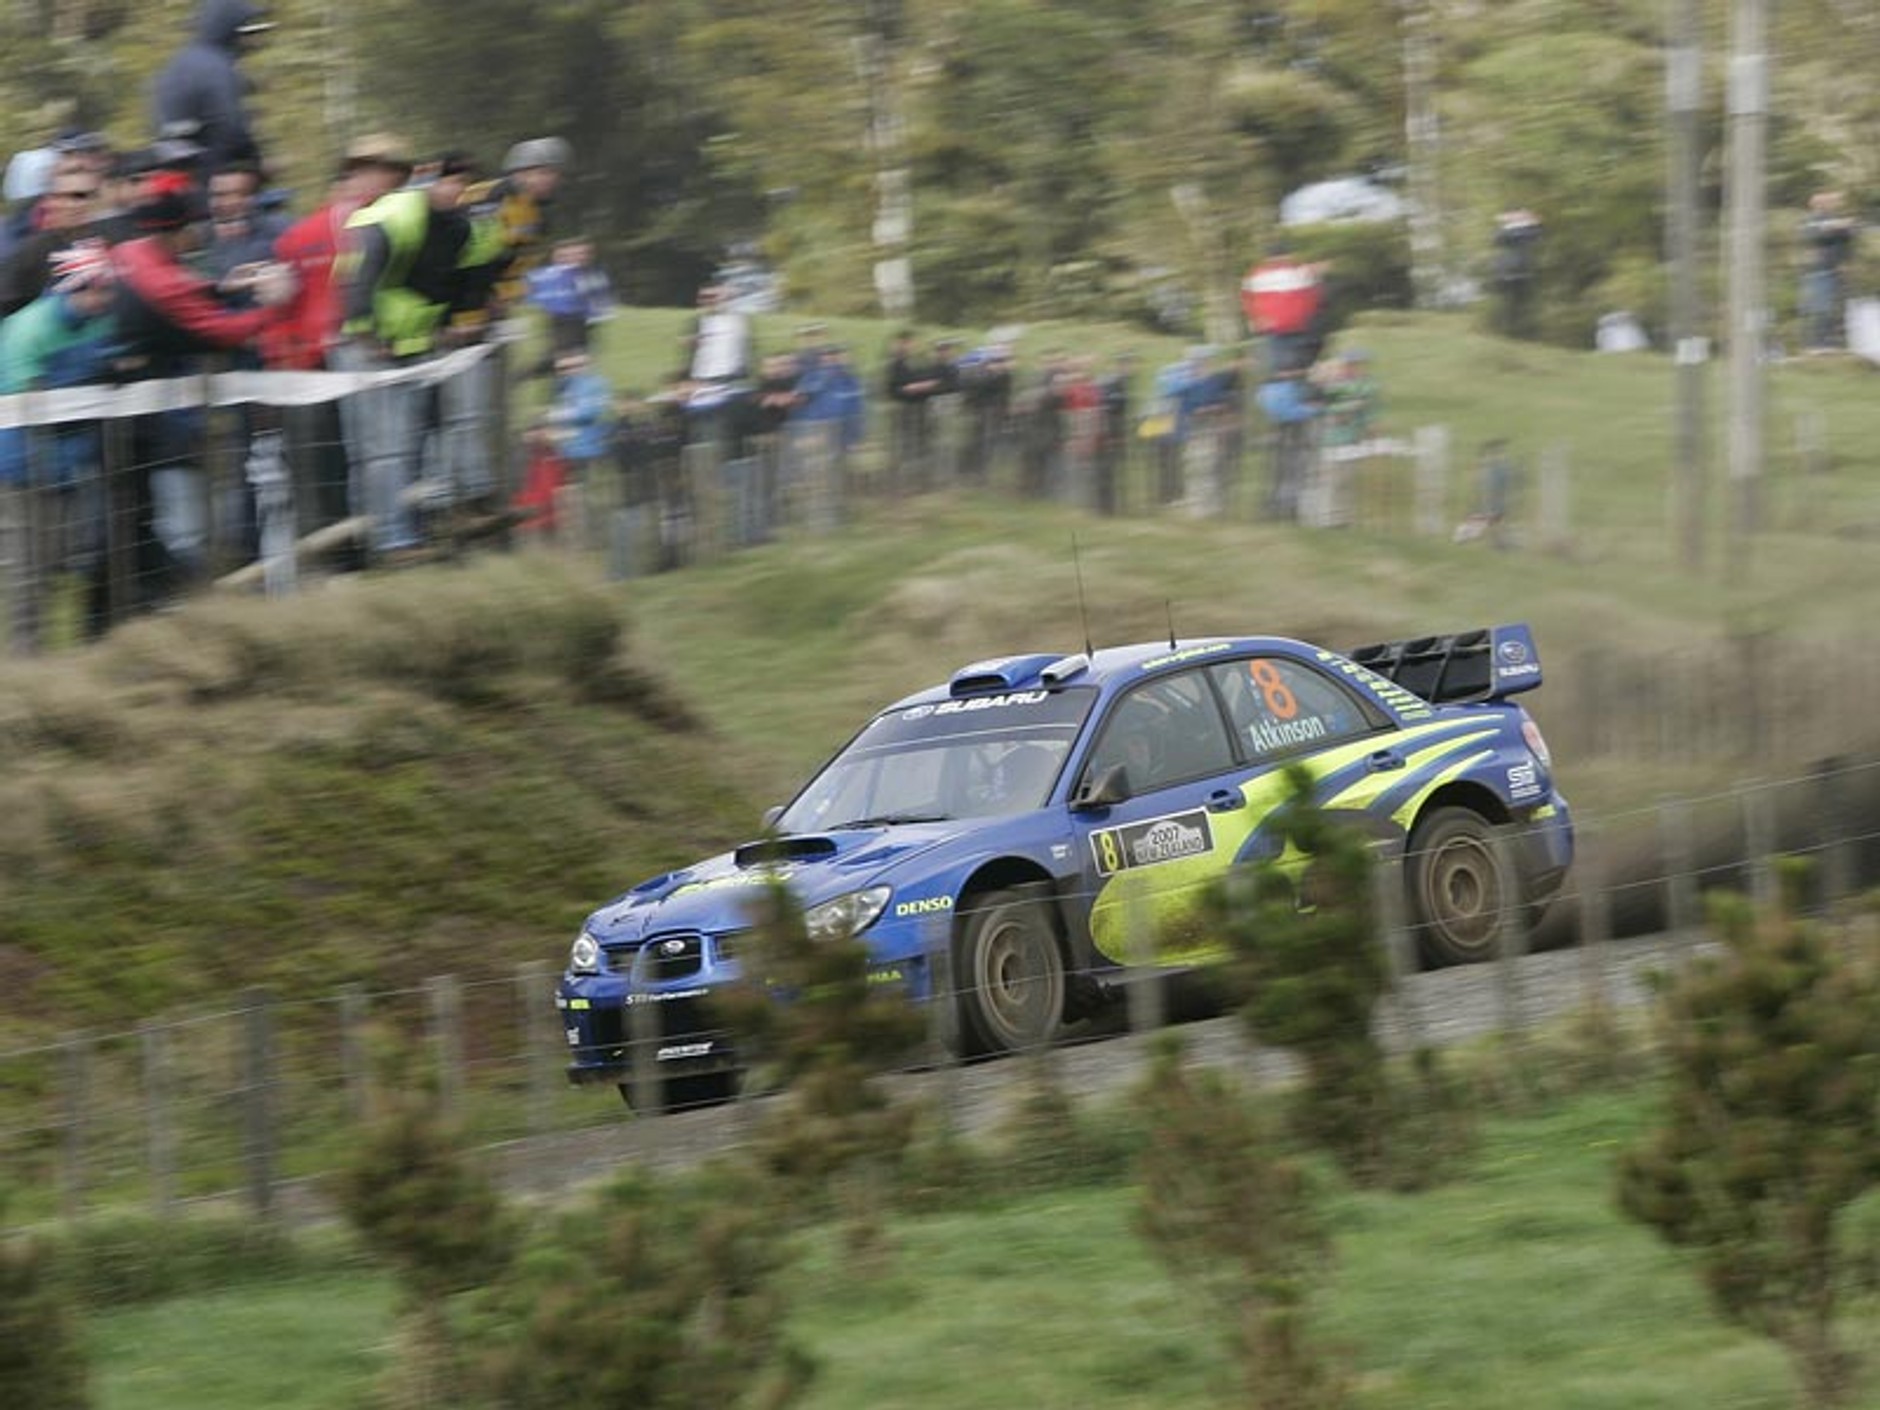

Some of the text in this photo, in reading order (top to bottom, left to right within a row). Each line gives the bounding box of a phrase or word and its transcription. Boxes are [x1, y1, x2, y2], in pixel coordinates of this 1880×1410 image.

[1249, 658, 1298, 719] 8
[934, 691, 1049, 715] SUBARU
[1249, 716, 1326, 753] Atkinson
[1150, 826, 1179, 845] 2007
[1160, 836, 1204, 857] ZEALAND
[1101, 832, 1118, 871] 8
[896, 895, 954, 916] DENSO
